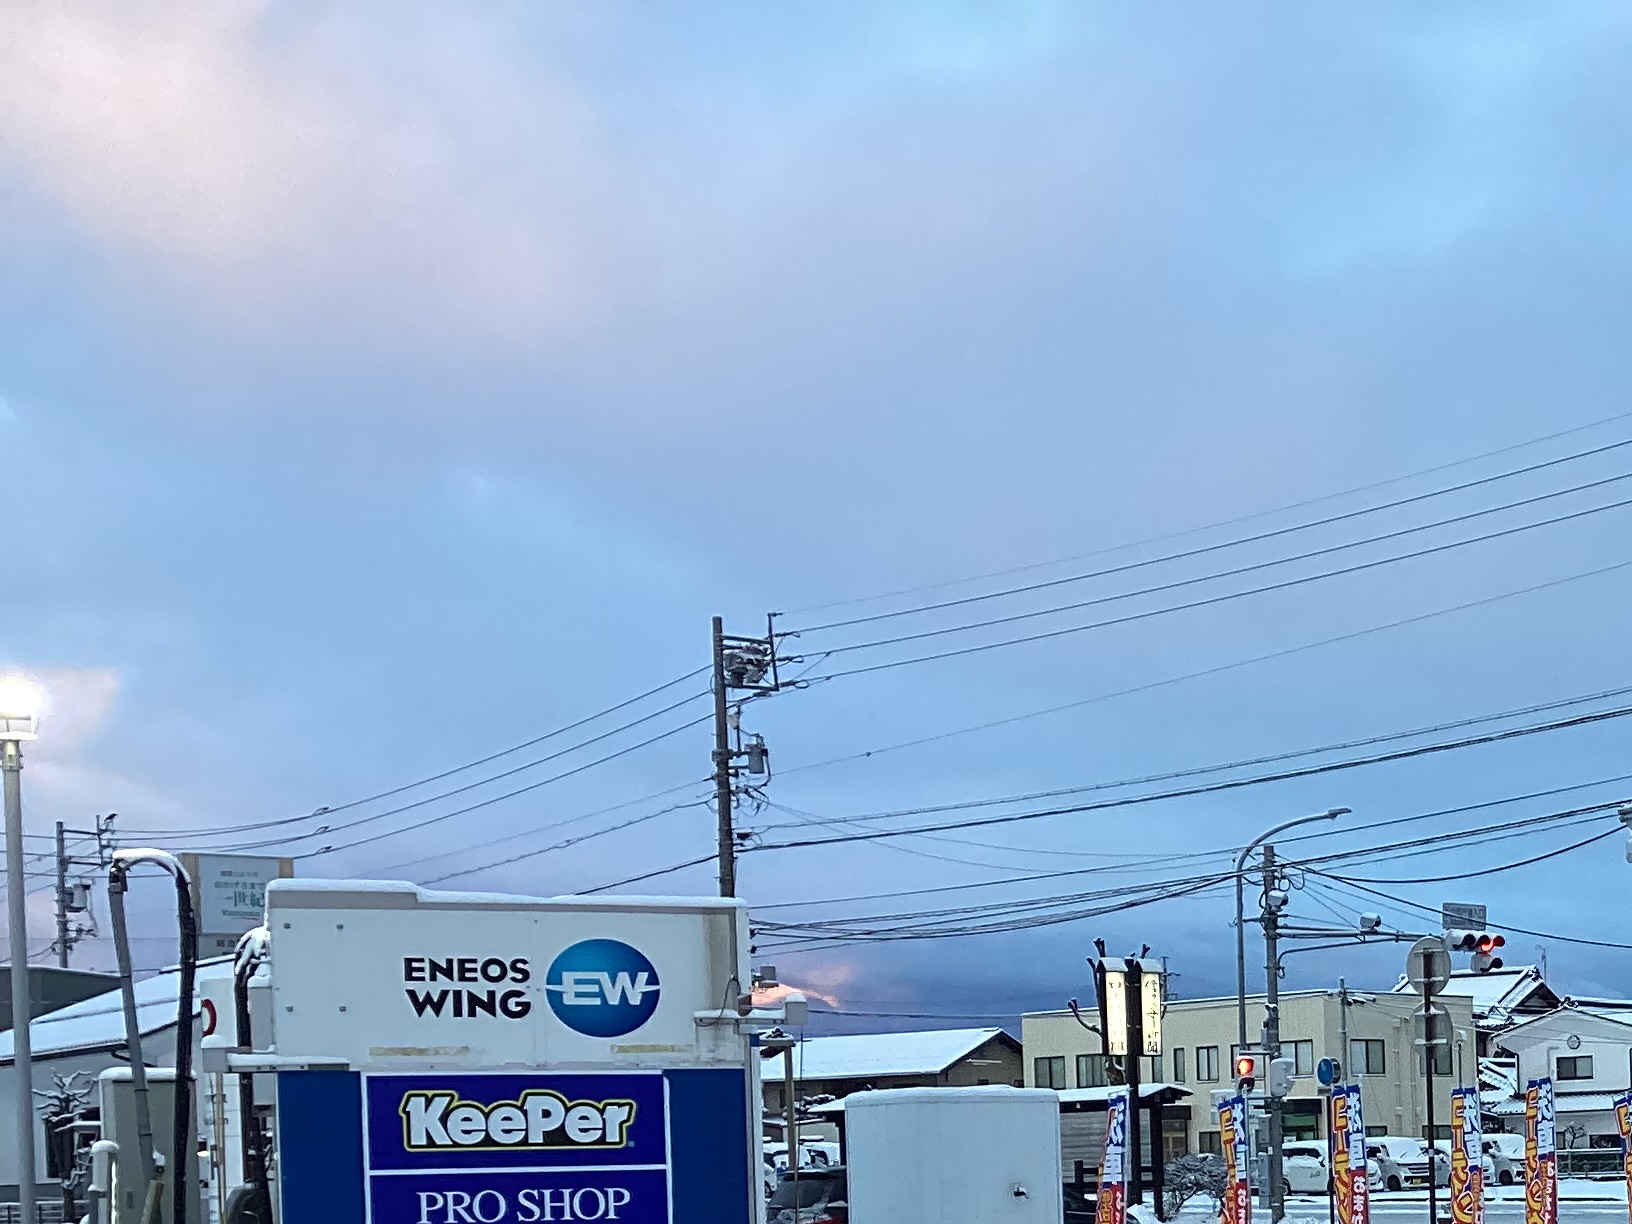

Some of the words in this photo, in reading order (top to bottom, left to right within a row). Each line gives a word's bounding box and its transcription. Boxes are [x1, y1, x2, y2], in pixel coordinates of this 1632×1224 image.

[403, 957, 531, 984] ENEOS
[405, 989, 531, 1019] WING
[561, 971, 649, 1006] EW
[401, 1091, 635, 1149] KeePer
[416, 1189, 507, 1224] PRO
[517, 1187, 631, 1222] SHOP
